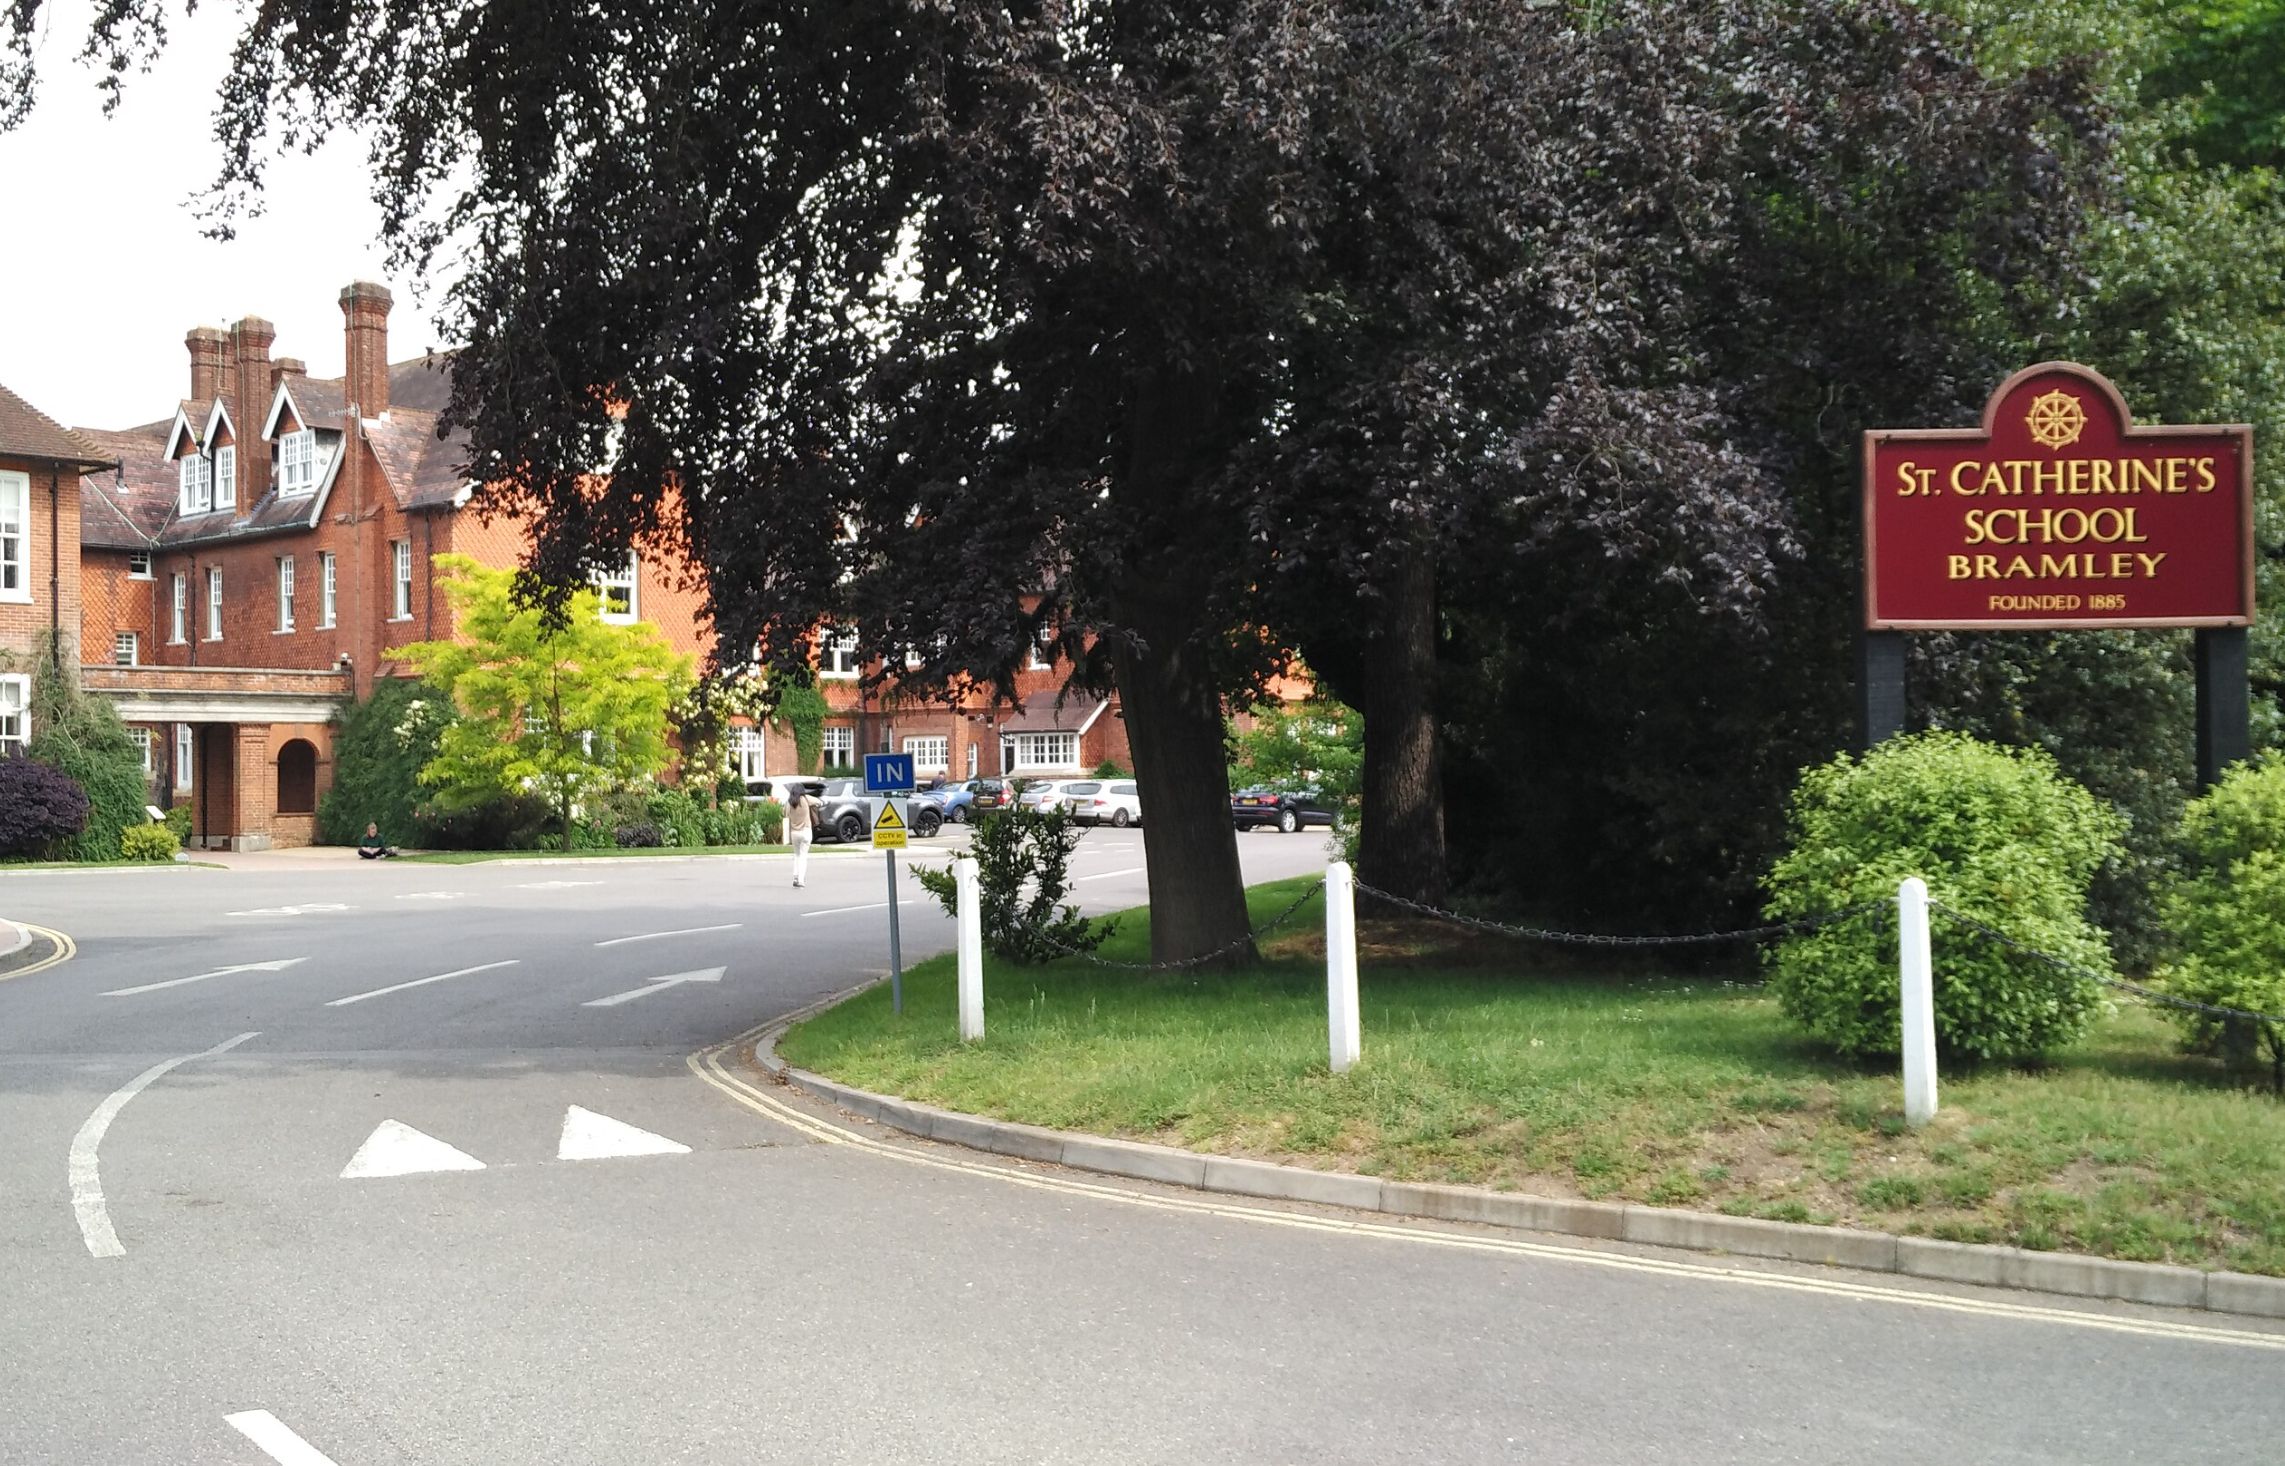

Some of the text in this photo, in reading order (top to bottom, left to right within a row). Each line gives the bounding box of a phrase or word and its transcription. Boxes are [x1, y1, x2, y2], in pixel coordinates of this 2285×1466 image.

[1950, 457, 2216, 495] CATHERINE'S
[1964, 507, 2148, 544] SCHOOL
[1948, 553, 2167, 580] BRAMLEY
[1989, 594, 2126, 611] FOUNDED 1885
[877, 762, 904, 783] IN
